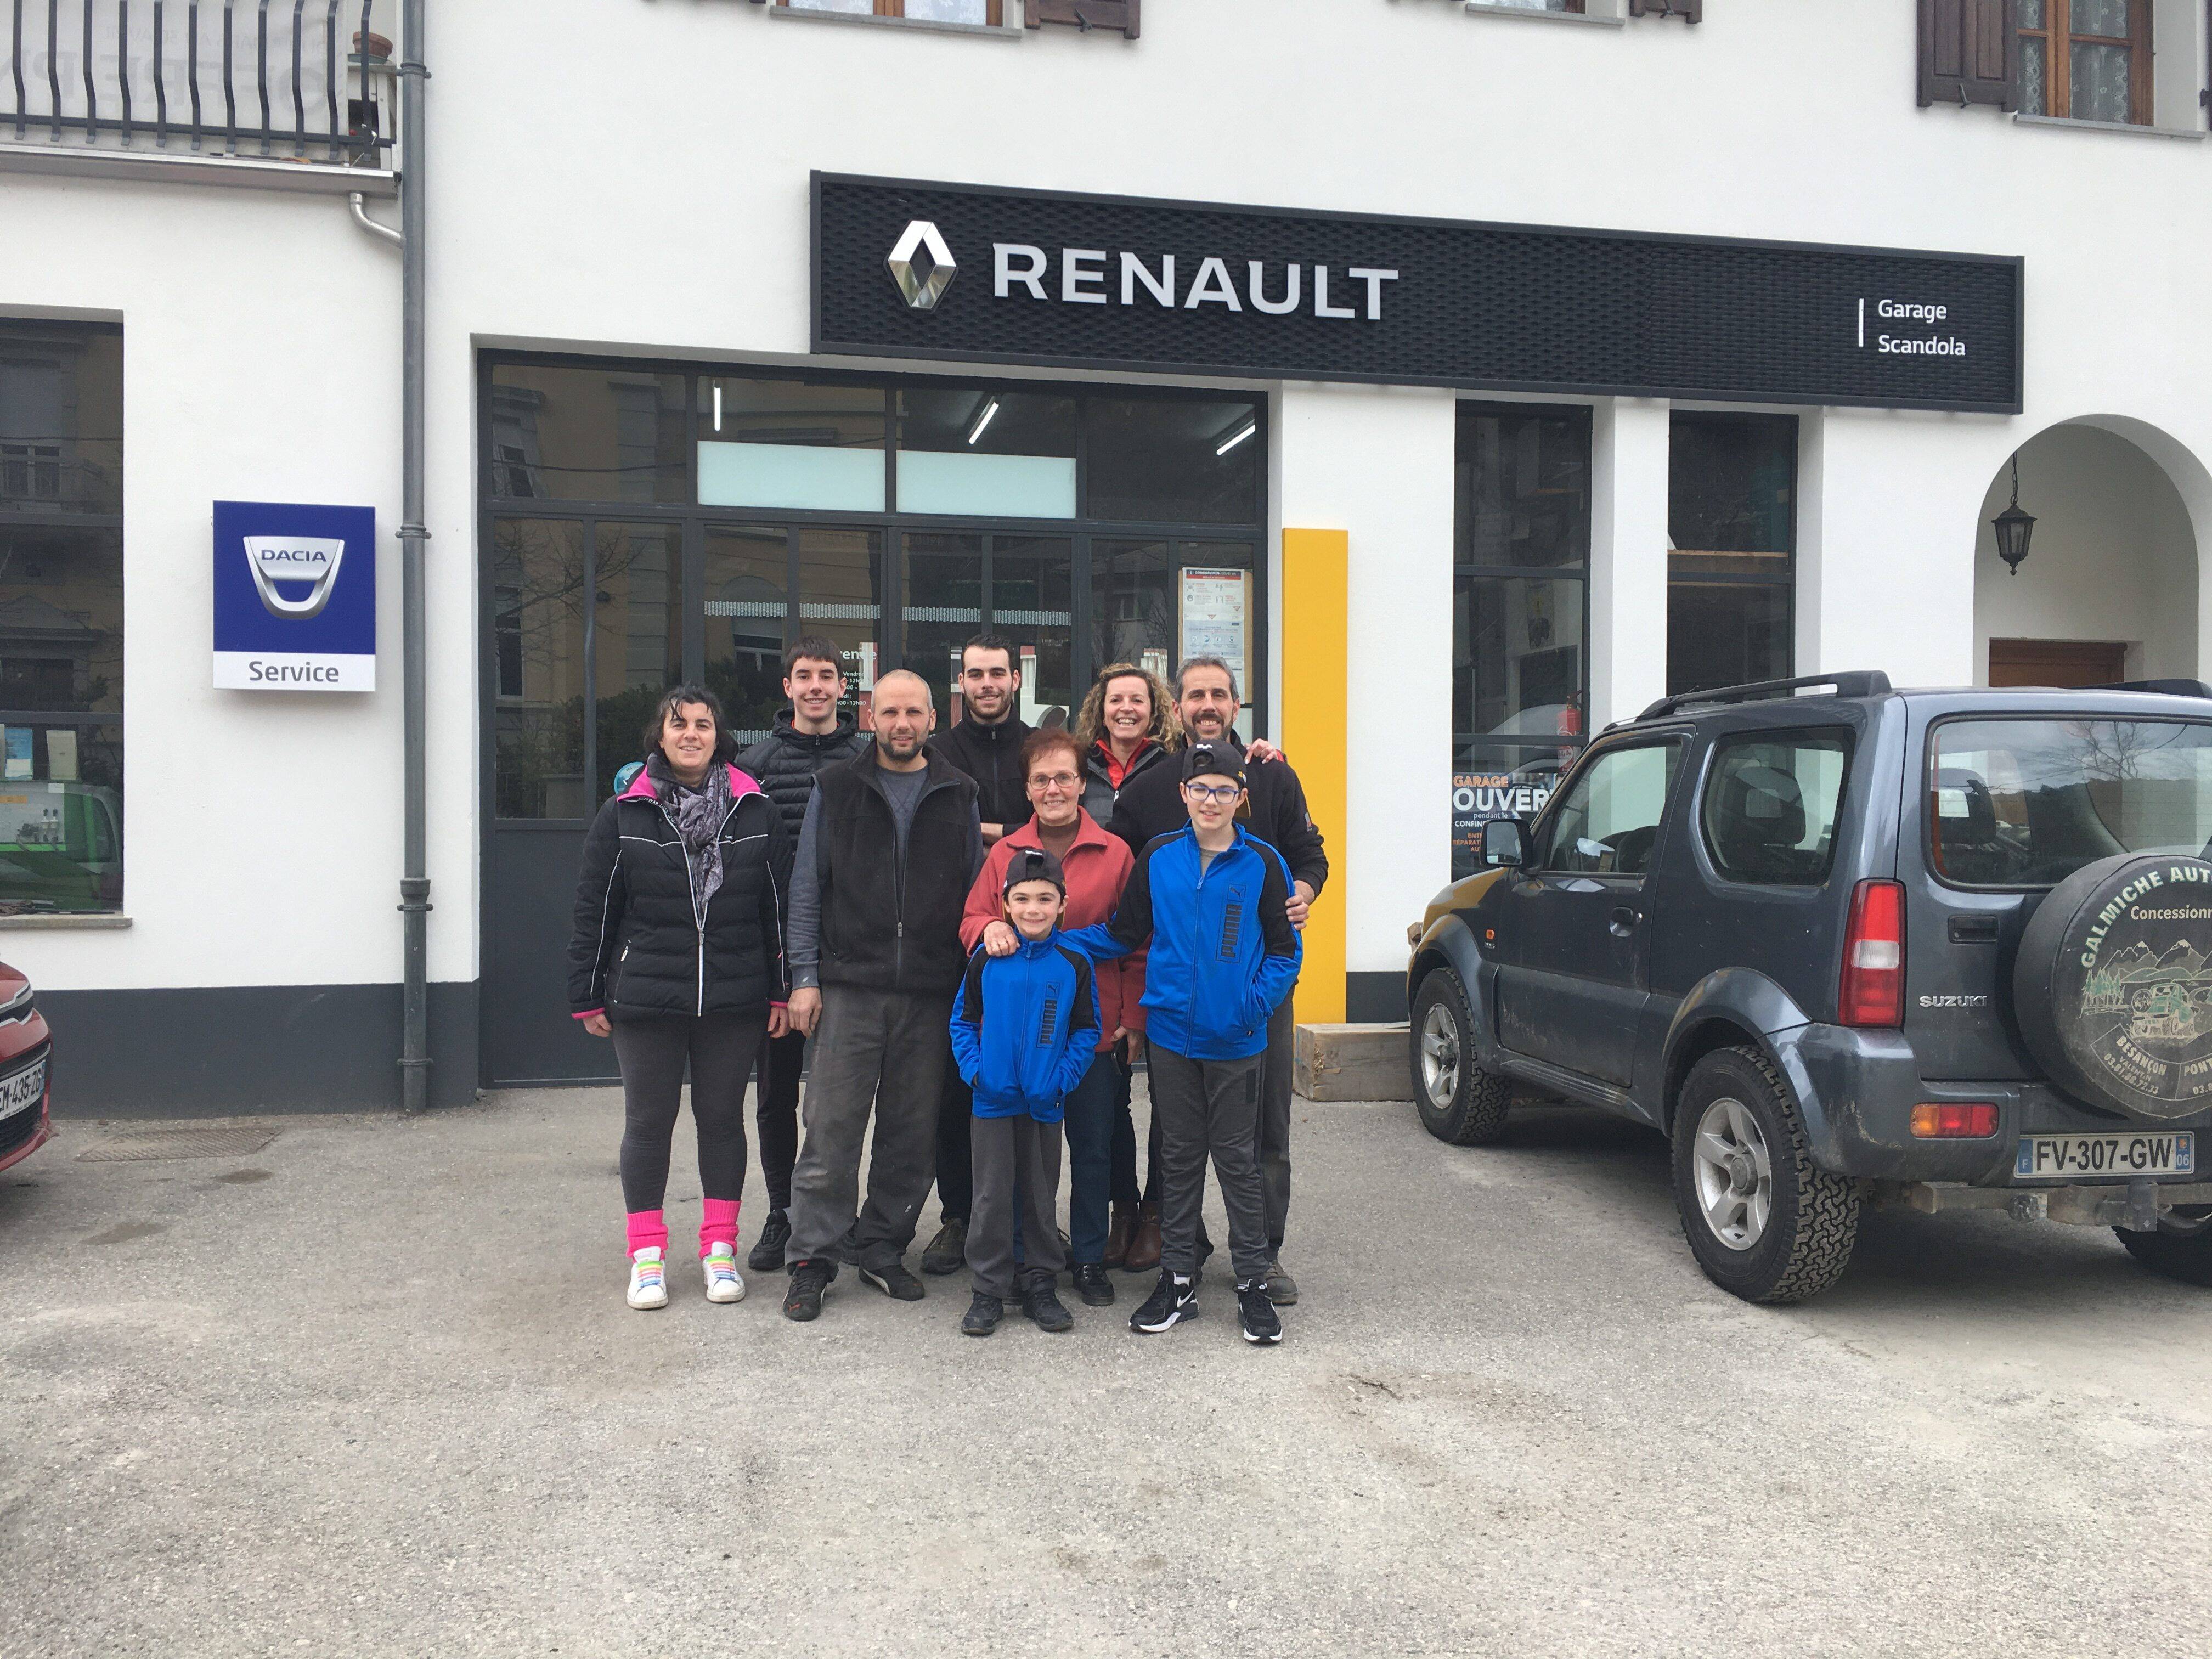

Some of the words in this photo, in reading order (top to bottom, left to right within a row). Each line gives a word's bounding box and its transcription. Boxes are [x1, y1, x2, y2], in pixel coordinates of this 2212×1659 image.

[993, 242, 1400, 320] RENAULT
[1878, 298, 1948, 324] Garage
[1878, 334, 1966, 356] Scandola
[261, 549, 327, 562] DACIA
[249, 661, 340, 682] Service
[1453, 775, 1509, 788] GARAGE
[1473, 811, 1500, 820] pendant
[2081, 871, 2164, 968] GALMICHE
[2170, 866, 2212, 883] AUT
[1221, 904, 1243, 958] PUMA
[1919, 995, 1988, 1007] SUZUKI
[1040, 999, 1058, 1045] PUMA
[2116, 1035, 2168, 1076] BESANÇON
[2022, 1159, 2029, 1169] F
[2036, 1138, 2172, 1171] FV-307-GW
[2176, 1153, 2190, 1166] 06
